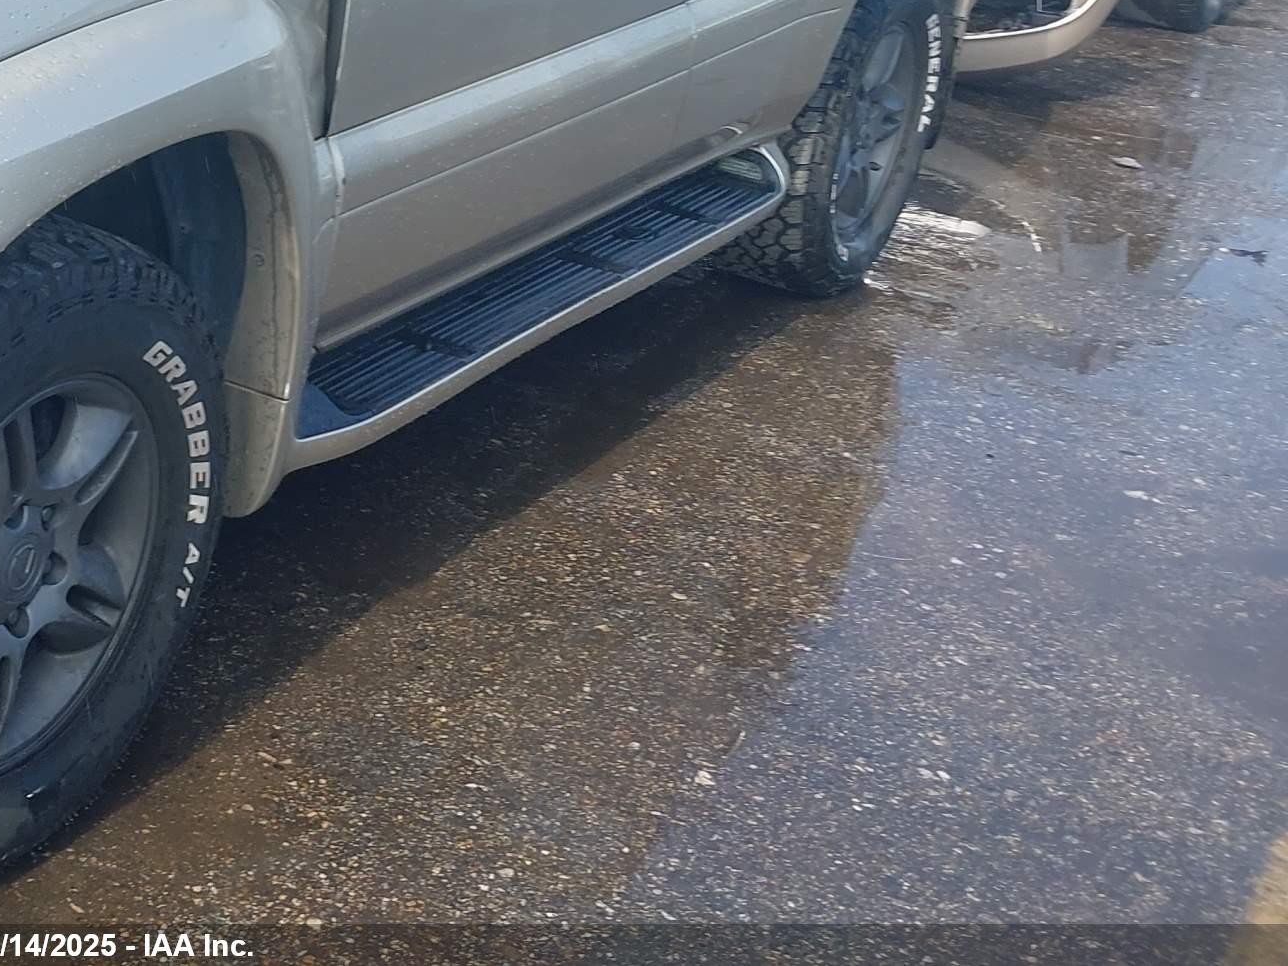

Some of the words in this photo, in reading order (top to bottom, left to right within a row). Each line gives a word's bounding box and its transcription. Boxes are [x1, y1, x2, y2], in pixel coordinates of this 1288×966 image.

[917, 13, 943, 133] GENERAL
[143, 340, 211, 525] GRABBER
[175, 542, 201, 608] A/T
